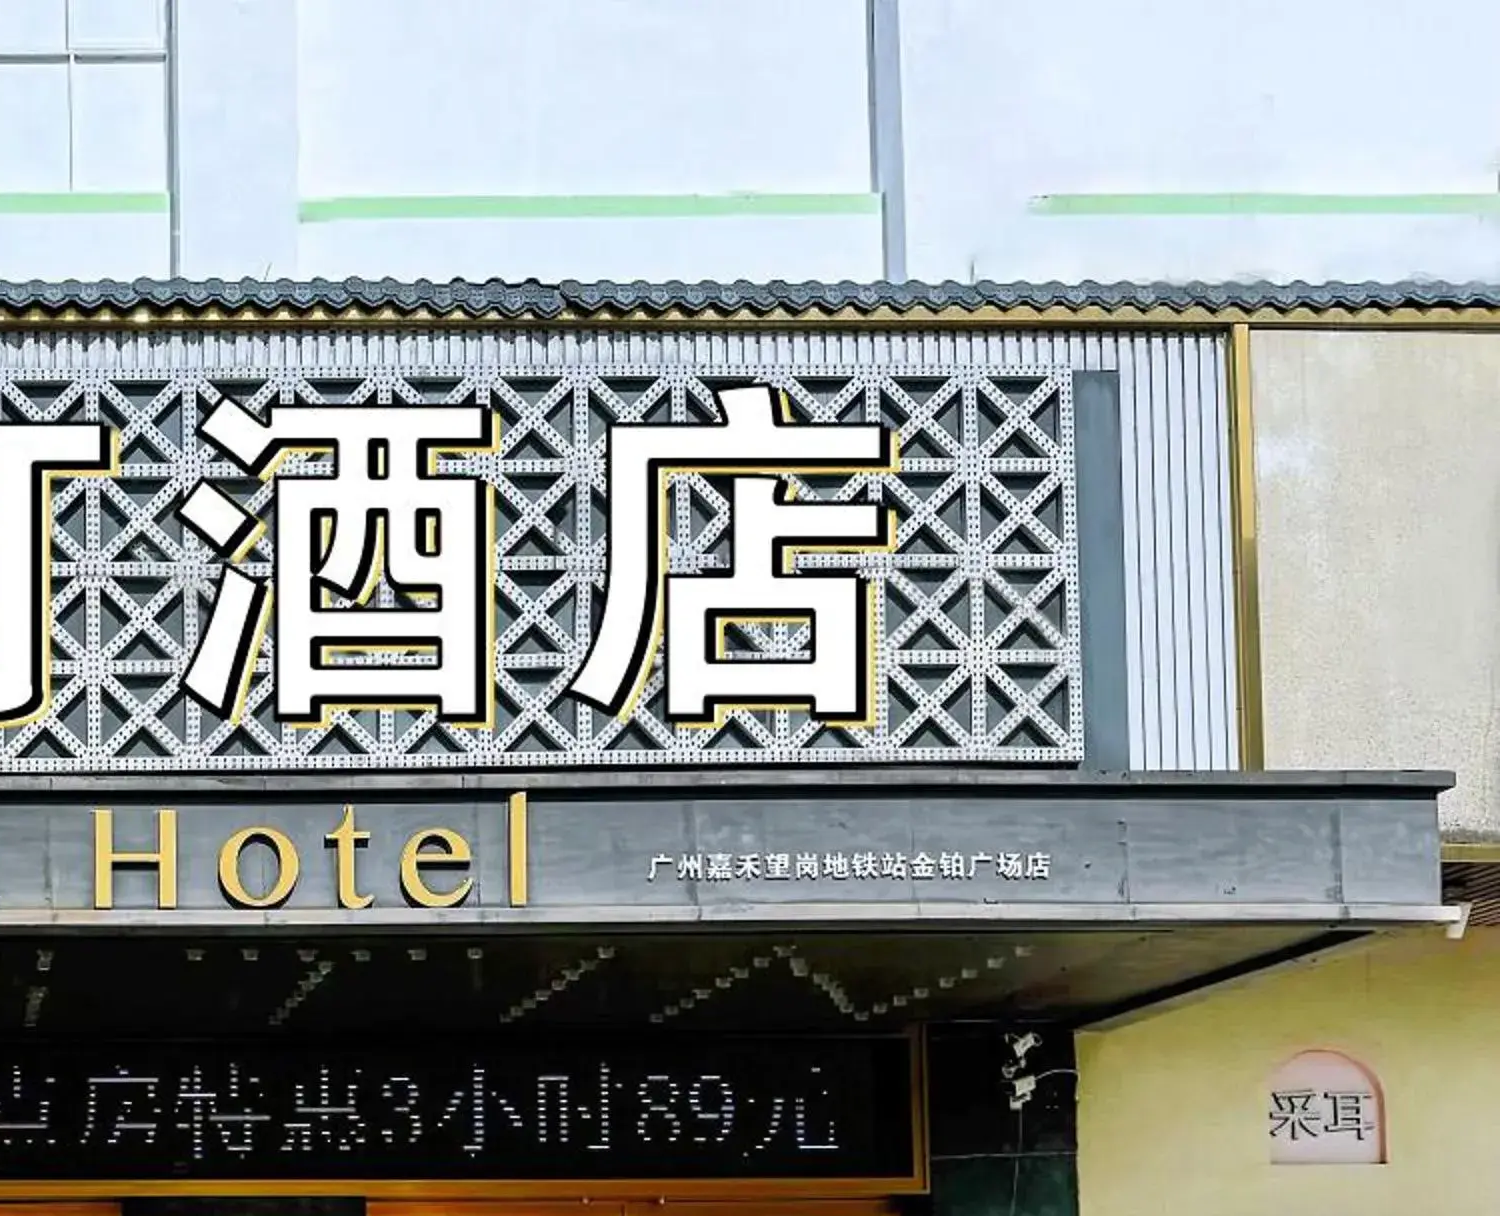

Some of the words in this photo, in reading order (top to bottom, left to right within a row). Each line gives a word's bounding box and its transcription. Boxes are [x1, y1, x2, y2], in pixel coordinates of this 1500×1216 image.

[92, 791, 528, 909] Hotel
[646, 852, 1053, 881] 广州嘉禾望岗地铁站金铂广场店
[1268, 1089, 1376, 1141] 采耳
